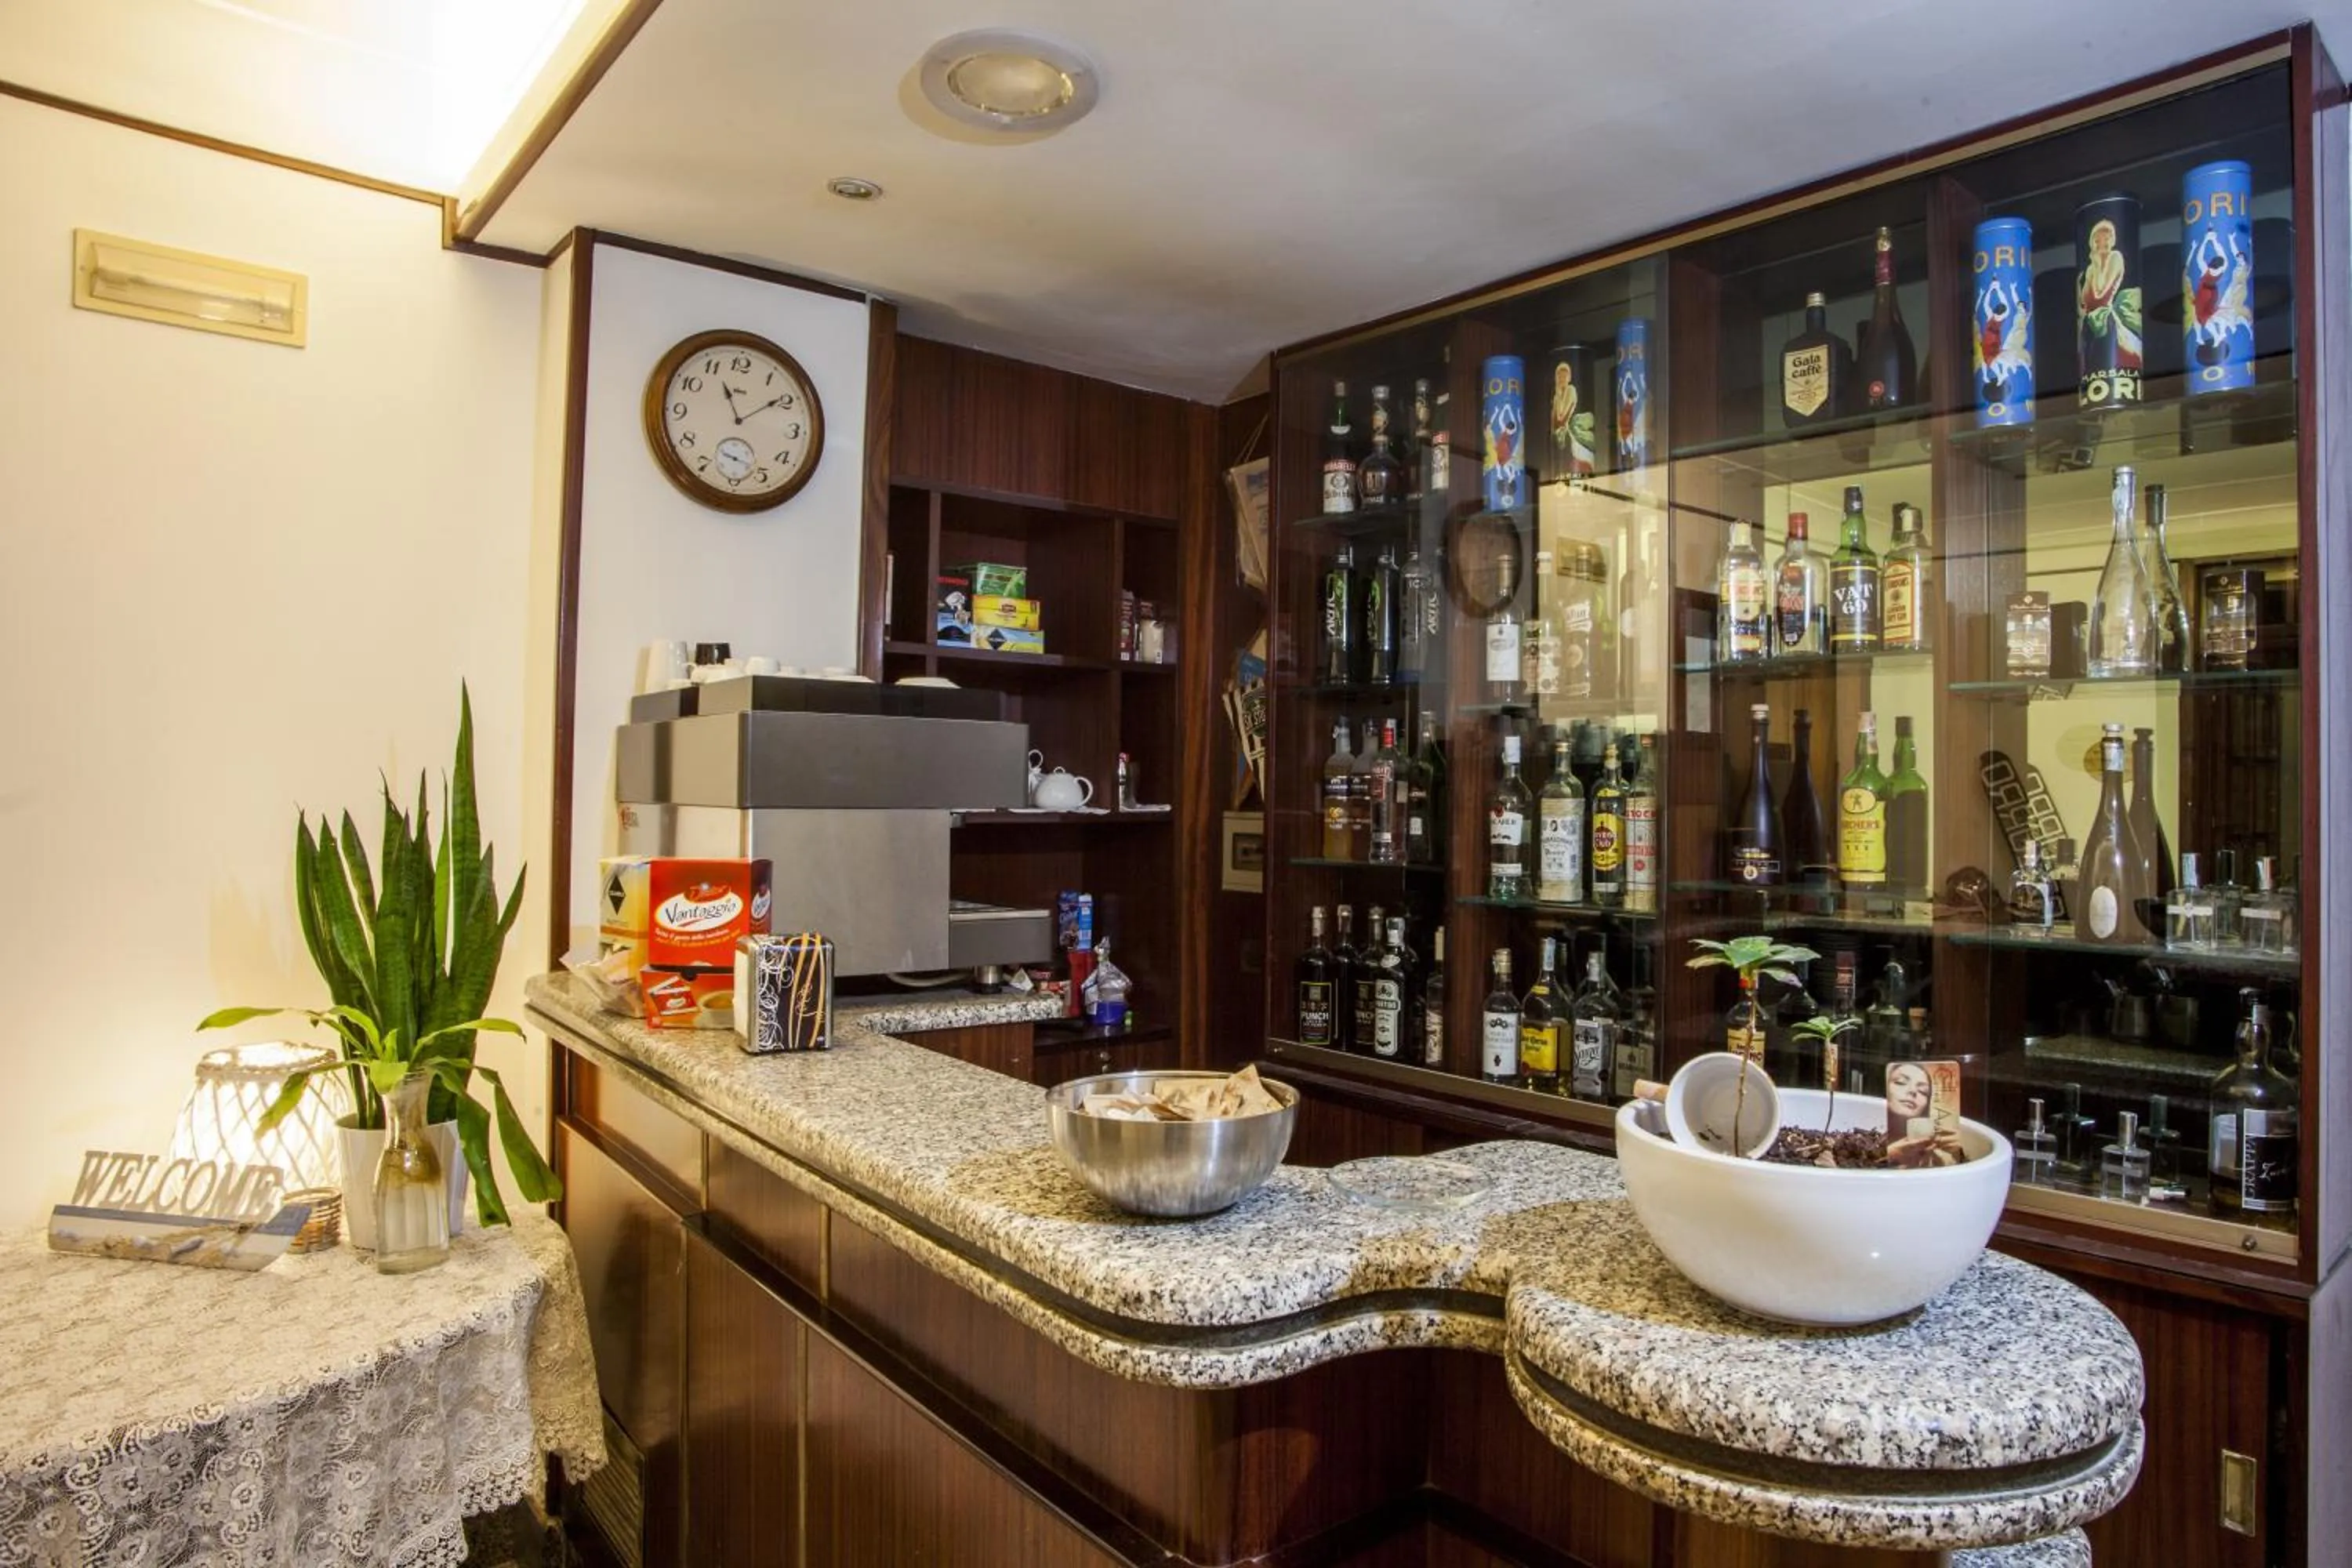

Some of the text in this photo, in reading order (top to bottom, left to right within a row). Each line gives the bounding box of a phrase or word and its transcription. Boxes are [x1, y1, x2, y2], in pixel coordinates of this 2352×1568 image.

[705, 359, 720, 375] 11
[731, 357, 751, 374] 12
[681, 376, 703, 392] 10
[765, 372, 774, 386] 1
[778, 394, 793, 409] 2
[673, 402, 688, 421] 9
[786, 423, 800, 440] 3
[679, 432, 695, 448] 8
[698, 455, 712, 472] 7
[775, 451, 789, 465] 4
[753, 467, 768, 483] 5
[1833, 583, 1873, 602] VAT
[665, 898, 736, 924] Vantaggio
[71, 1150, 285, 1219] WELCOME
